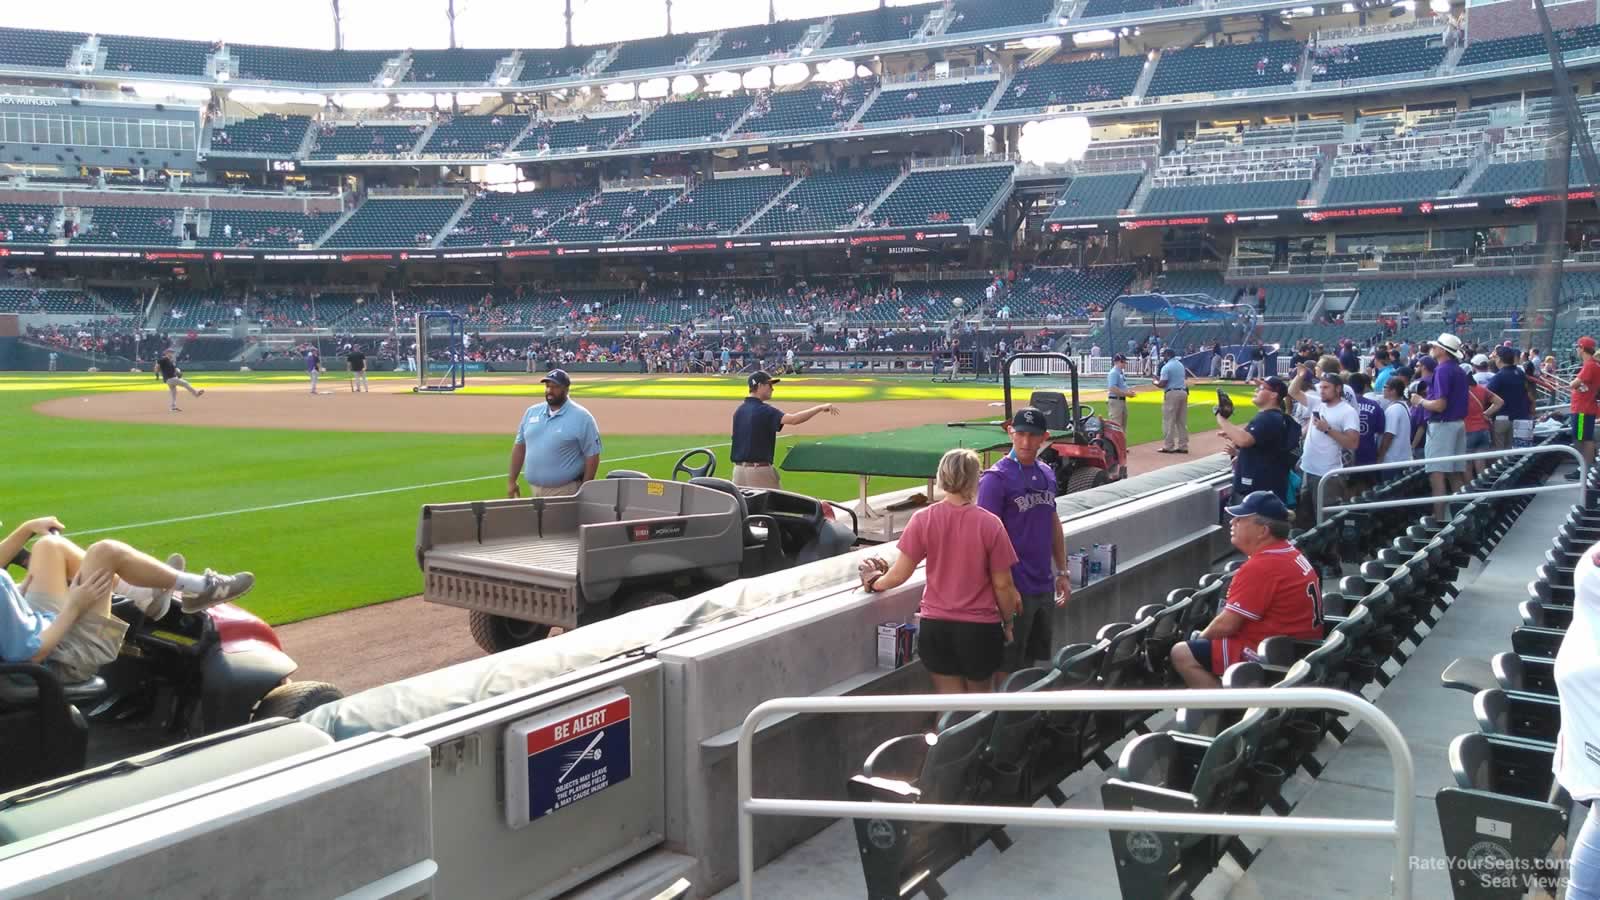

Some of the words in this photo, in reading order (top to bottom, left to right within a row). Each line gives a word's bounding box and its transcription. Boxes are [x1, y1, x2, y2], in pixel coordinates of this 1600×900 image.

[16, 98, 57, 107] MINOLTA
[213, 585, 231, 598] N
[554, 722, 570, 742] BE
[572, 709, 607, 735] ALERT
[555, 778, 579, 793] OBJECTS
[579, 773, 591, 783] MAY
[591, 766, 608, 778] LEAVE
[557, 790, 568, 800] THE
[568, 780, 591, 795] PLAYING
[591, 774, 606, 786] FIELD
[560, 797, 572, 806] MAY
[573, 788, 590, 801] CAUSE
[590, 780, 609, 793] INJURY
[1490, 823, 1497, 832] 3
